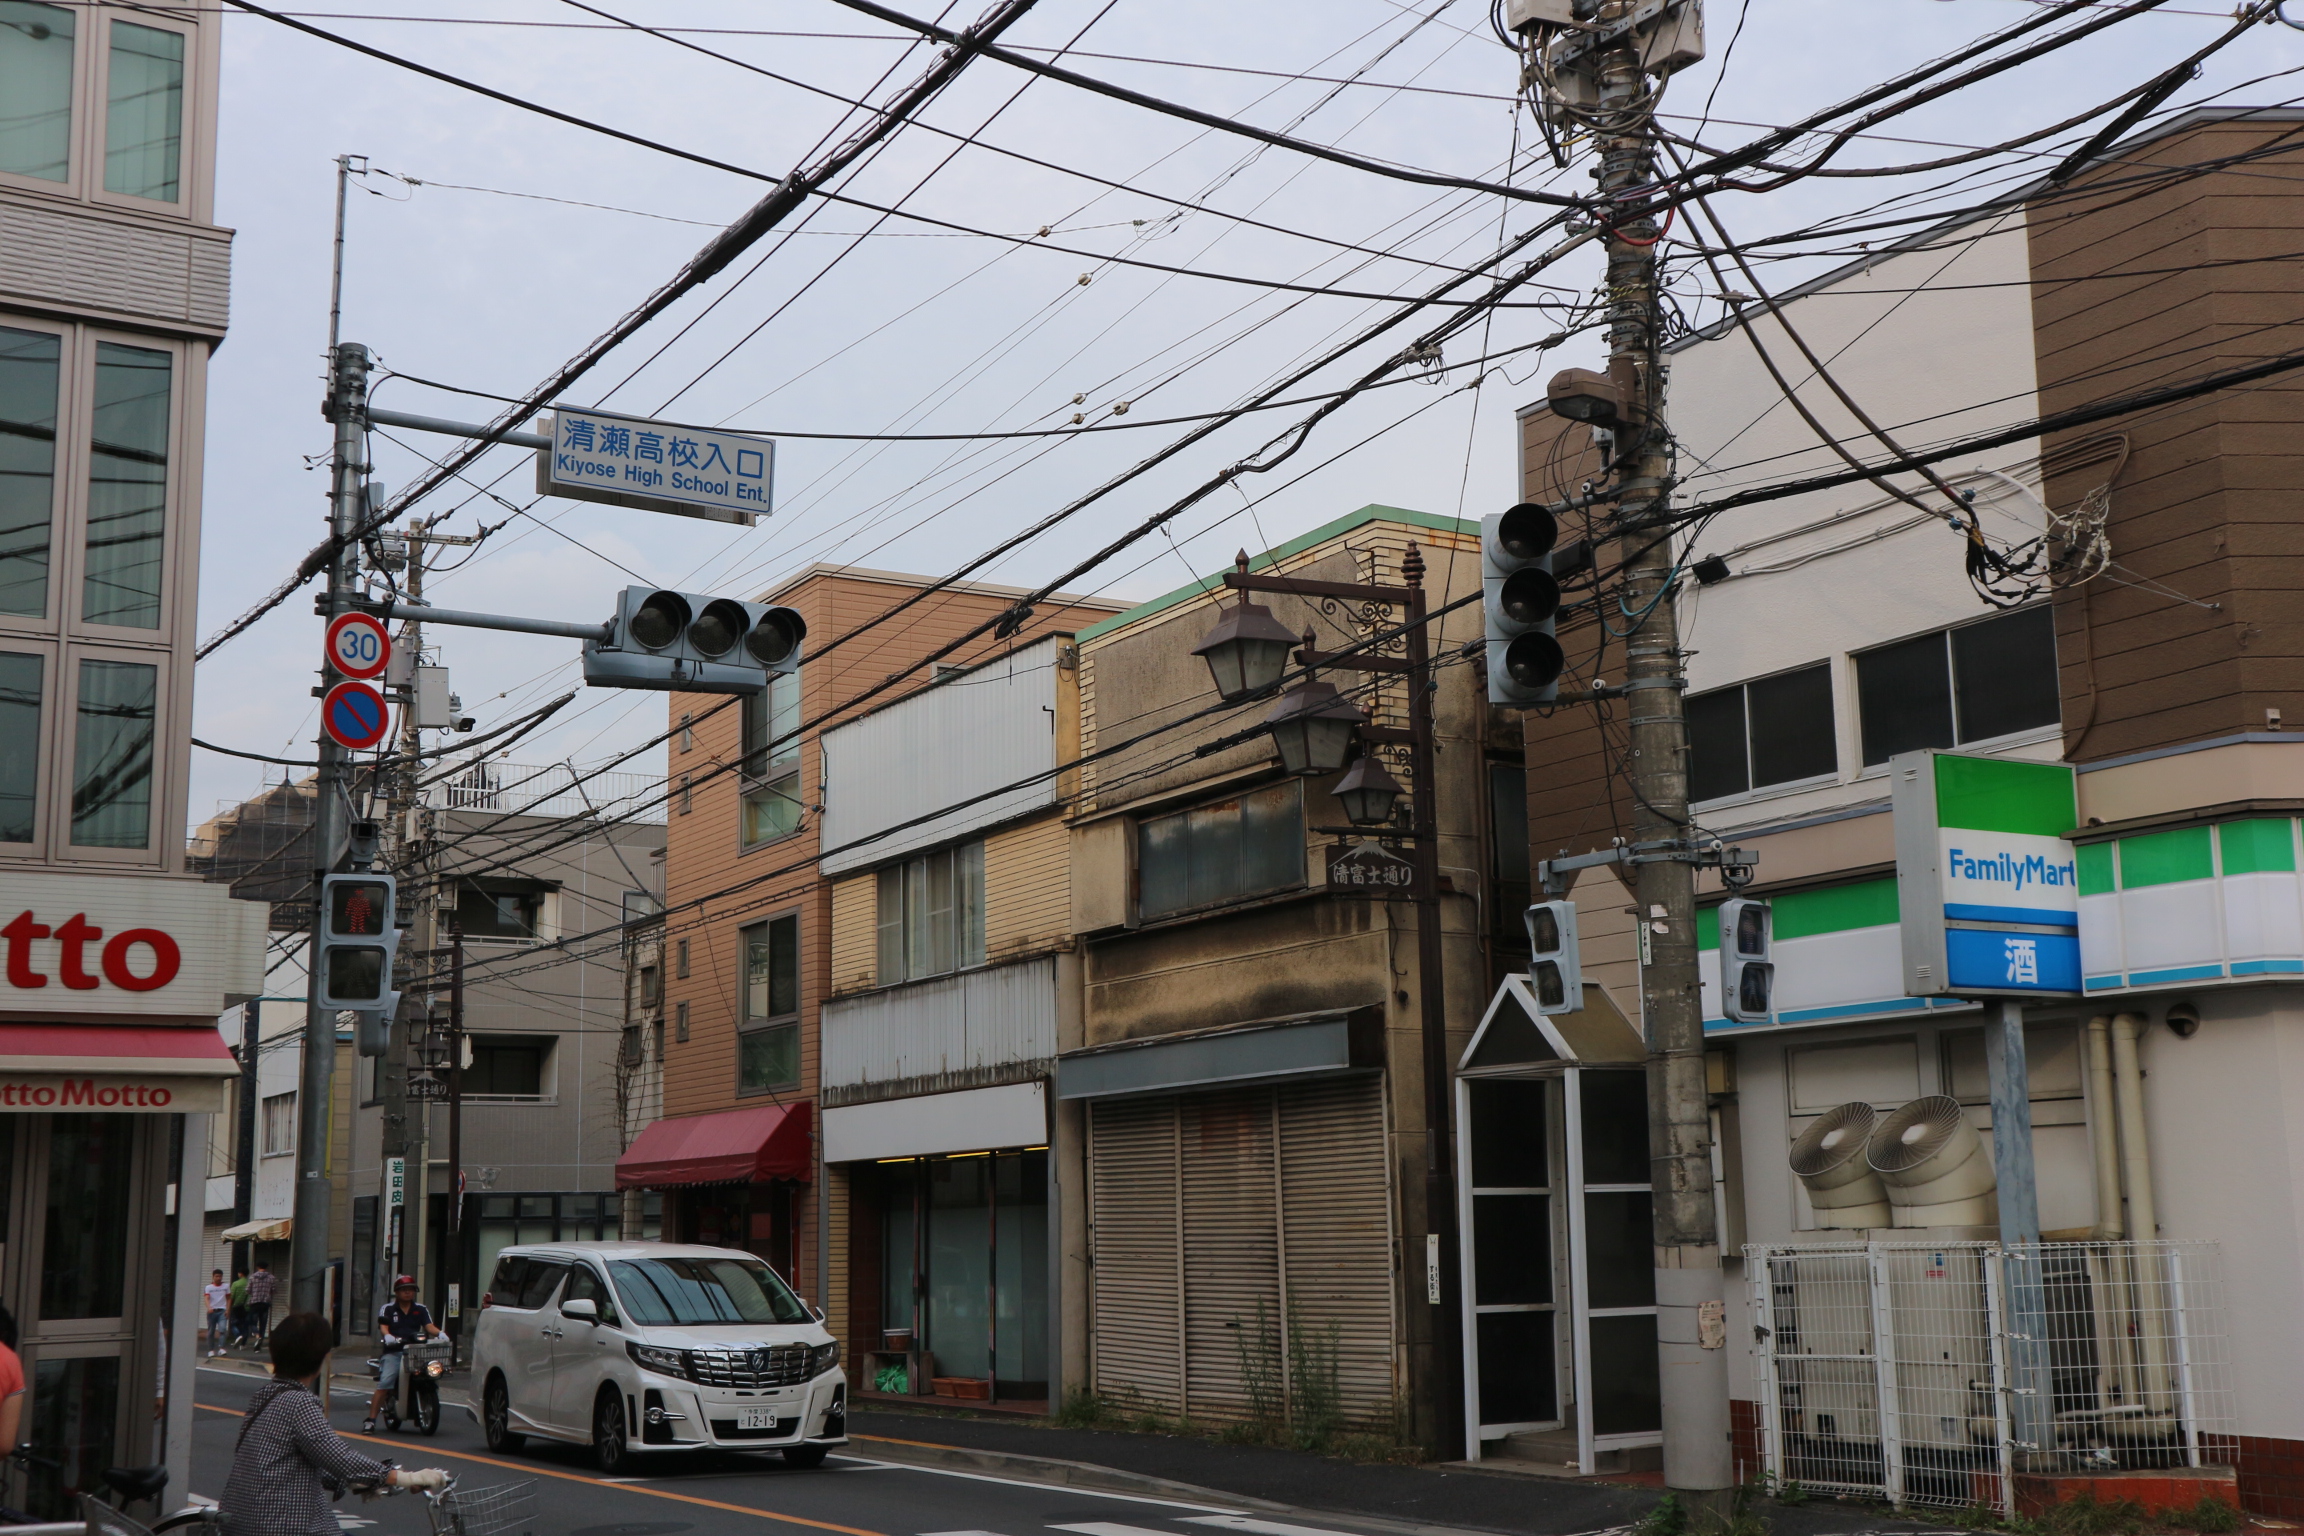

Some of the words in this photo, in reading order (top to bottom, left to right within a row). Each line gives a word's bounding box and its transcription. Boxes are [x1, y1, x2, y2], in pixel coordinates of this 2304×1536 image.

[562, 418, 764, 479] 清瀬高校入口
[557, 453, 616, 478] Kiyose
[624, 464, 663, 487] High
[671, 472, 729, 496] School
[736, 482, 768, 504] Ent.
[341, 630, 377, 662] 30
[1333, 863, 1413, 886] 清富士通り
[1949, 848, 2076, 891] FamilyMart
[2004, 938, 2039, 984] 酒
[0, 1082, 57, 1106] tto
[60, 1078, 172, 1107] Motto
